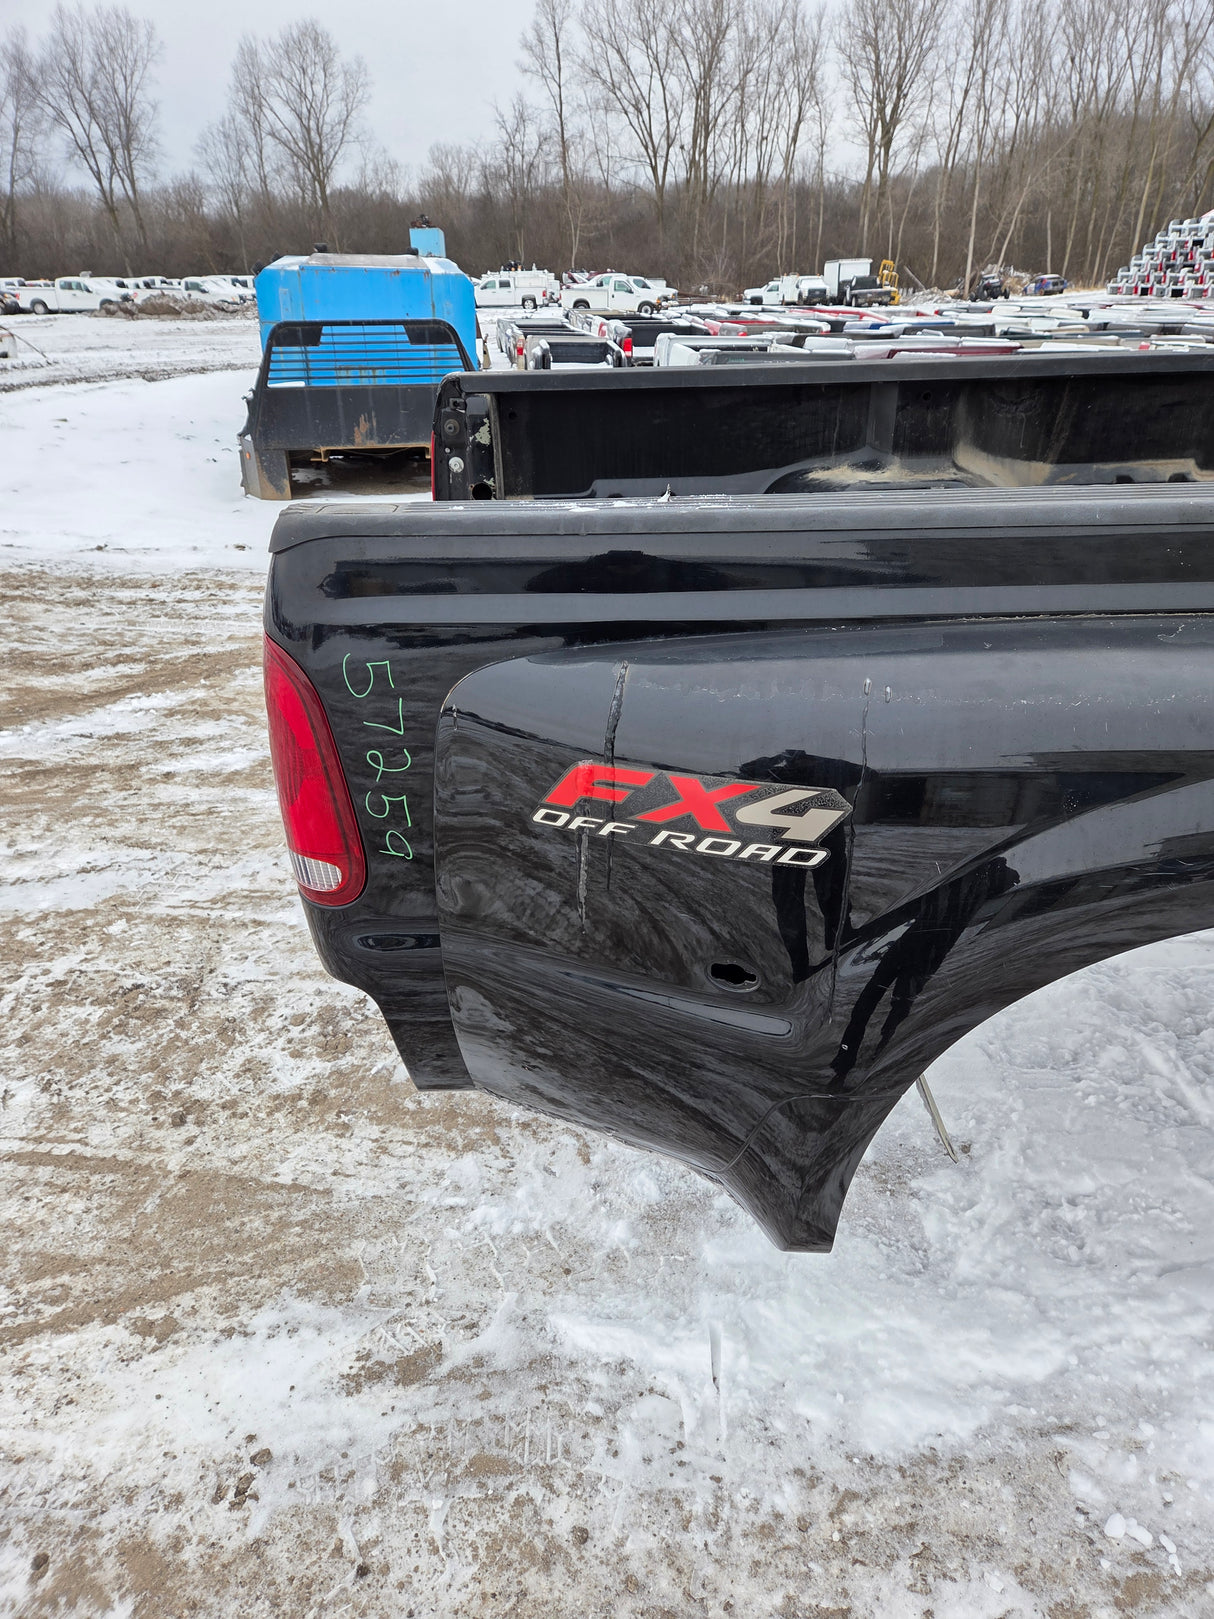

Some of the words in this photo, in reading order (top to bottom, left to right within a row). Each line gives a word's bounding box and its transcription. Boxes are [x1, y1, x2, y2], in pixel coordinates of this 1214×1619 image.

[342, 652, 413, 860] 57259
[532, 808, 636, 836] OFF
[650, 830, 830, 867] ROAD
[545, 763, 848, 842] FX4
